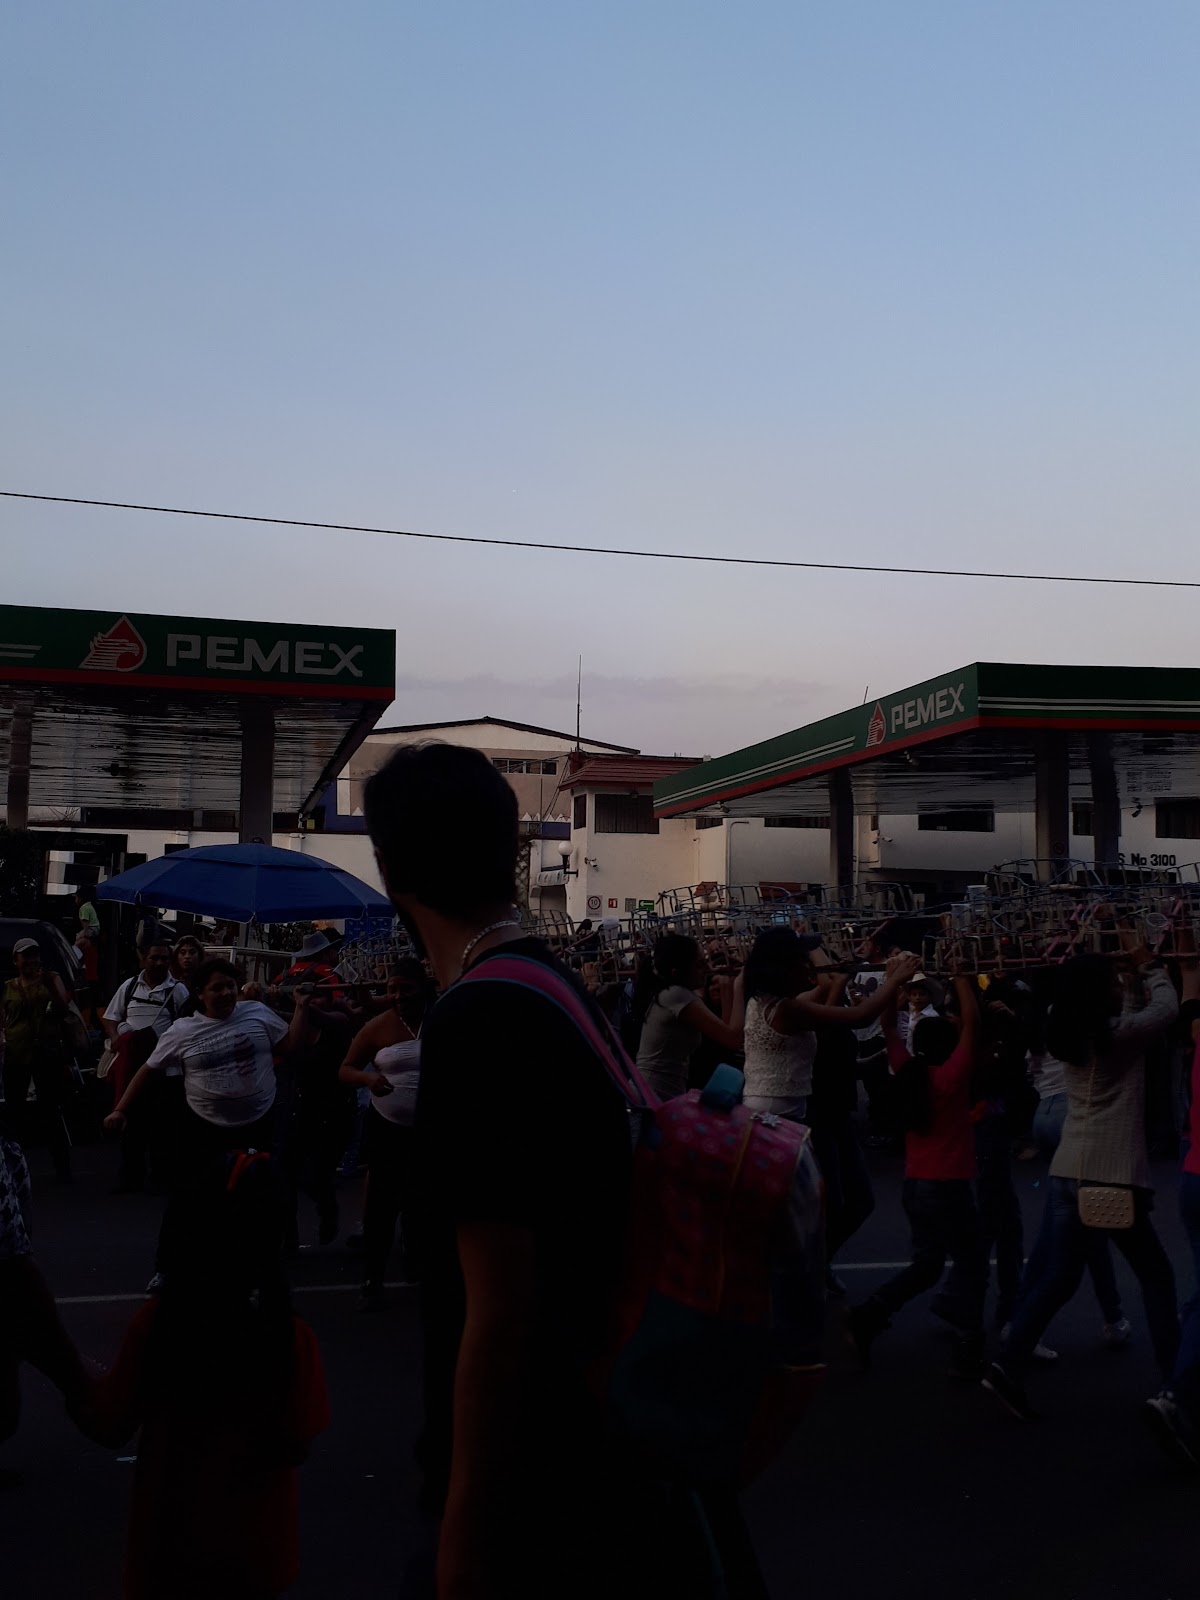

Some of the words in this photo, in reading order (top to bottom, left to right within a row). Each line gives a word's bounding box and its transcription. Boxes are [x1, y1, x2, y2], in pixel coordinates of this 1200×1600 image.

[166, 634, 364, 677] PEMEX
[891, 683, 965, 734] PEMEX
[1150, 854, 1176, 866] 3100
